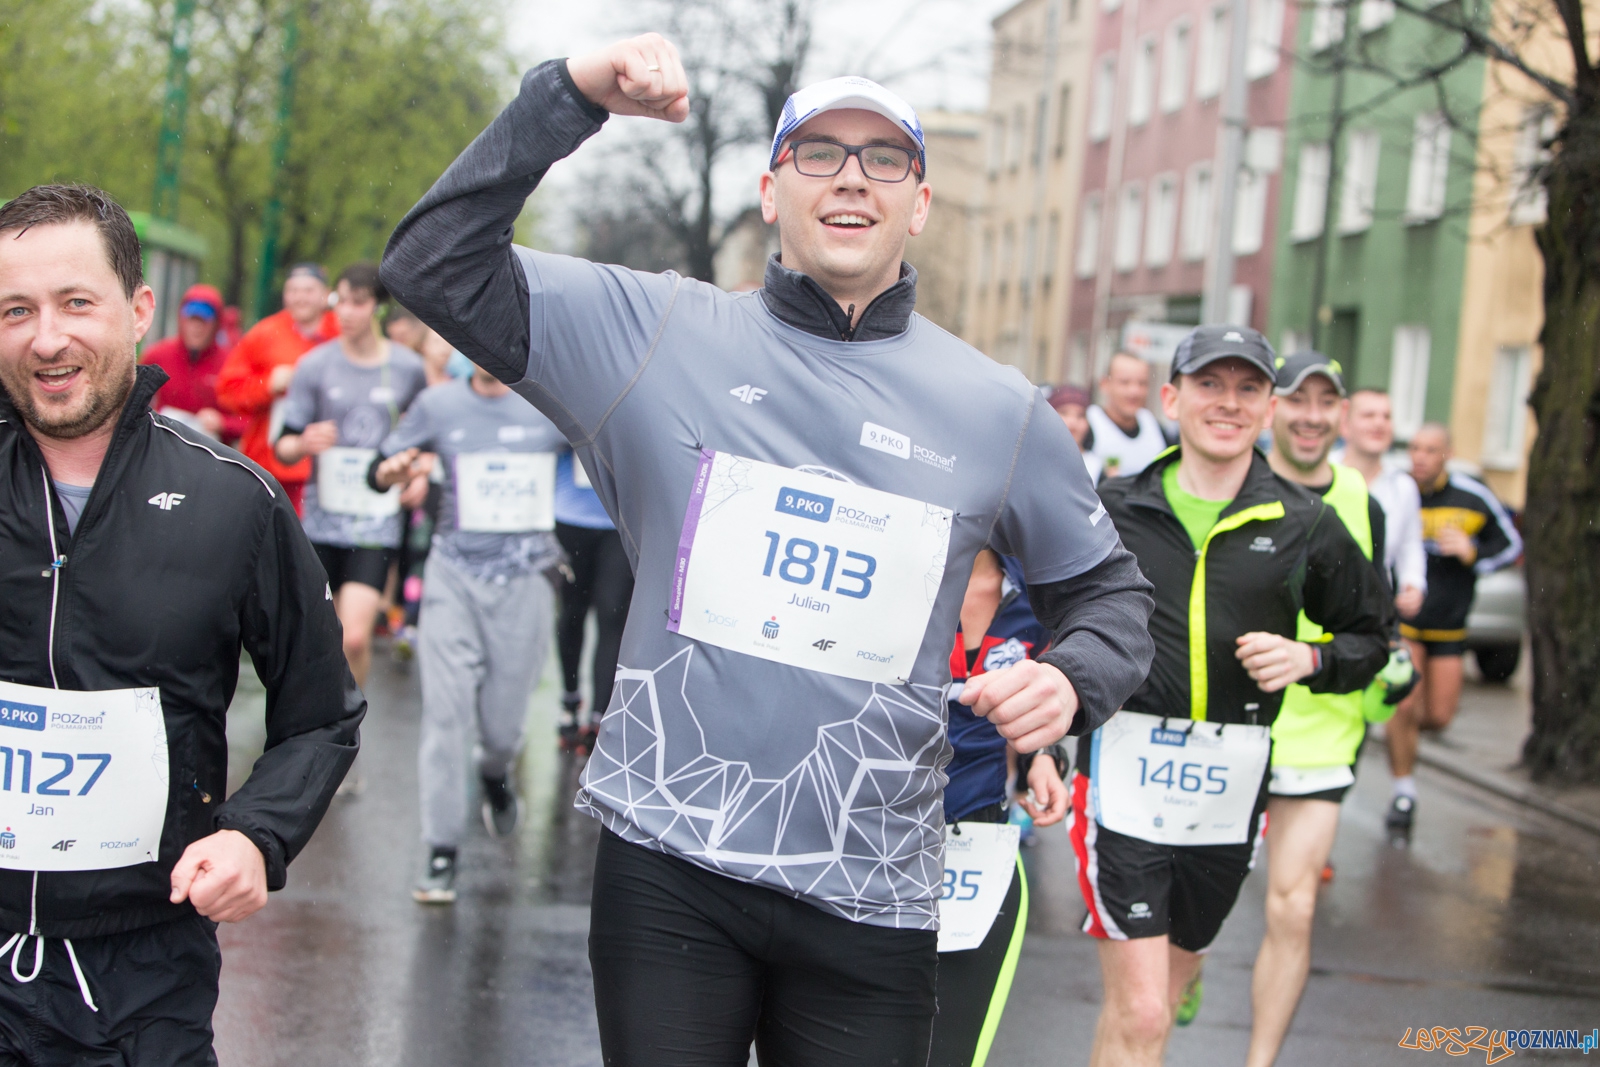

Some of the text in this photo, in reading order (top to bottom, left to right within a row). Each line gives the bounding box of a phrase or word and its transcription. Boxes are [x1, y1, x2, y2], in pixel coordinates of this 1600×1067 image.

[730, 384, 768, 404] 4F
[148, 492, 185, 510] 4F
[762, 530, 877, 600] 1813
[787, 593, 831, 614] Julian
[812, 638, 837, 652] 4F
[1138, 757, 1229, 795] 1465
[27, 803, 55, 816] Jan
[52, 839, 77, 851] 4F
